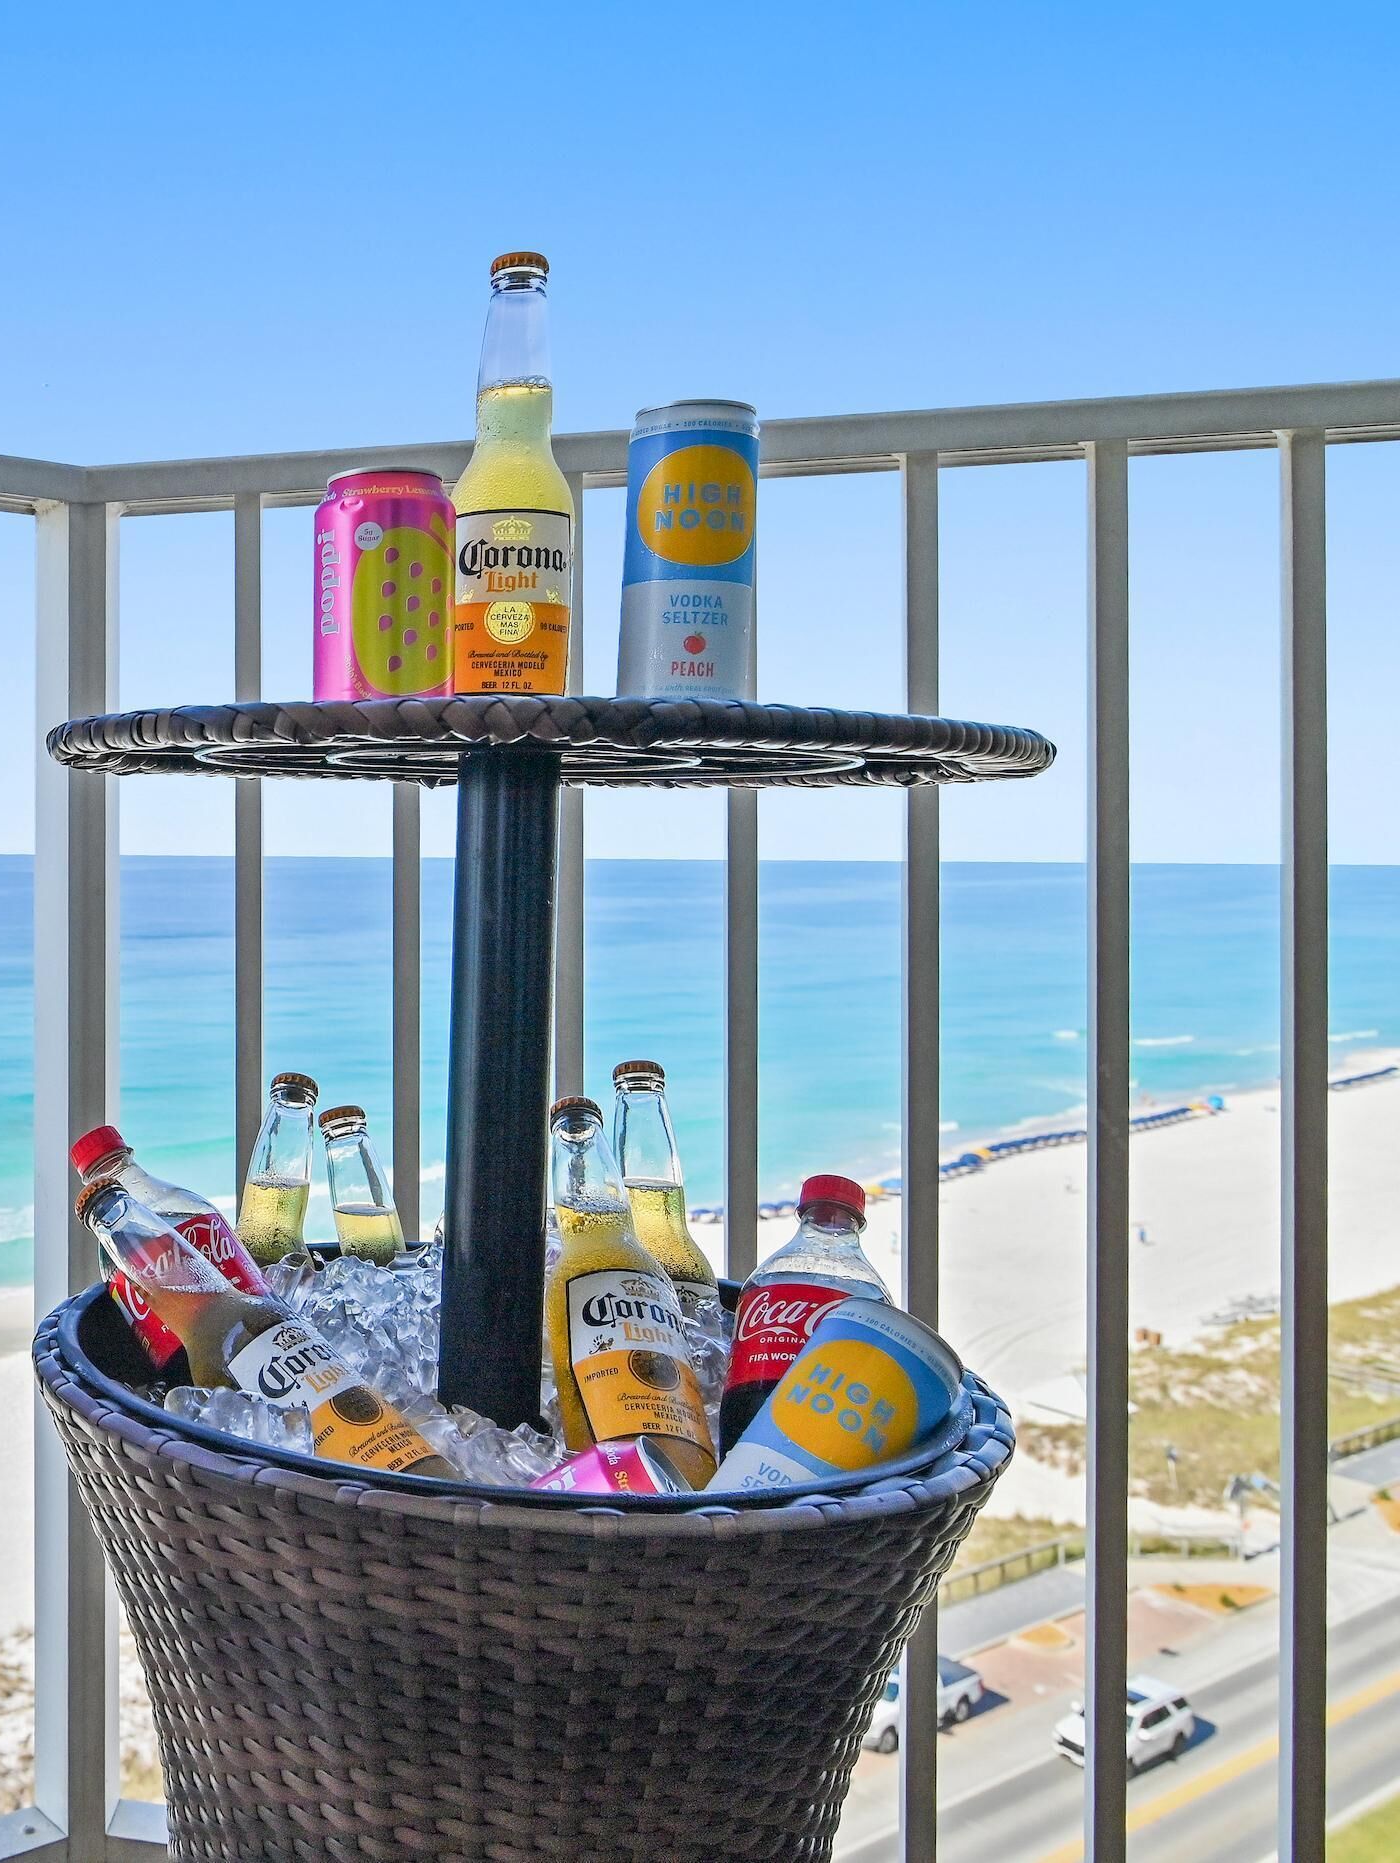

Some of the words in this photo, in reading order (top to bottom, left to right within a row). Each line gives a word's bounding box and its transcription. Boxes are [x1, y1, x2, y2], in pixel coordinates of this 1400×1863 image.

[683, 420, 696, 428] 100
[698, 420, 732, 428] CALORIES
[341, 485, 403, 498] Strawberry
[663, 481, 742, 505] HIGH
[654, 508, 747, 533] NOON
[357, 534, 380, 542] Sugar
[458, 538, 563, 579] Corona
[317, 528, 341, 637] poppi
[483, 570, 538, 593] Light
[669, 594, 723, 609] VODKA
[490, 613, 529, 621] CERVEZA
[662, 611, 729, 626] SELTZER
[455, 622, 475, 632] PORTED
[499, 628, 519, 636] FINA
[467, 650, 495, 659] Brewed
[496, 650, 511, 659] and
[511, 649, 540, 660] Bottled
[540, 651, 549, 661] by
[471, 660, 515, 669] CERVECERIA
[517, 661, 545, 670] MODELO
[493, 669, 522, 677] MEXICO
[671, 661, 714, 677] PEACH
[481, 681, 498, 689] BEER
[502, 681, 510, 689] 12
[582, 1292, 681, 1334] Coron
[737, 1291, 846, 1342] Coca-C
[759, 1335, 807, 1345] ORIGINA
[865, 1316, 879, 1328] 100
[880, 1323, 918, 1349] CALORIES
[749, 1352, 769, 1364] FIFA
[770, 1351, 797, 1362] WOR
[258, 1343, 340, 1399] Coro
[301, 1363, 346, 1393] Ligh
[584, 1367, 619, 1384] IMPORTED
[616, 1392, 652, 1402] Brewed
[651, 1394, 668, 1402] and
[807, 1363, 897, 1426] HIGH
[624, 1402, 675, 1414] CERVECERIA
[653, 1410, 683, 1424] MEXICO
[787, 1382, 888, 1454] NOON
[642, 1422, 661, 1431] BEER
[665, 1423, 674, 1433] 12
[314, 1425, 335, 1447] ORTED
[348, 1432, 377, 1458] Brewed
[376, 1425, 389, 1438] and
[360, 1433, 401, 1463] CERVECERIA
[387, 1438, 413, 1454] MEXICO
[386, 1457, 405, 1471] BEER
[404, 1451, 414, 1460] 12
[758, 1462, 792, 1486] VOD
